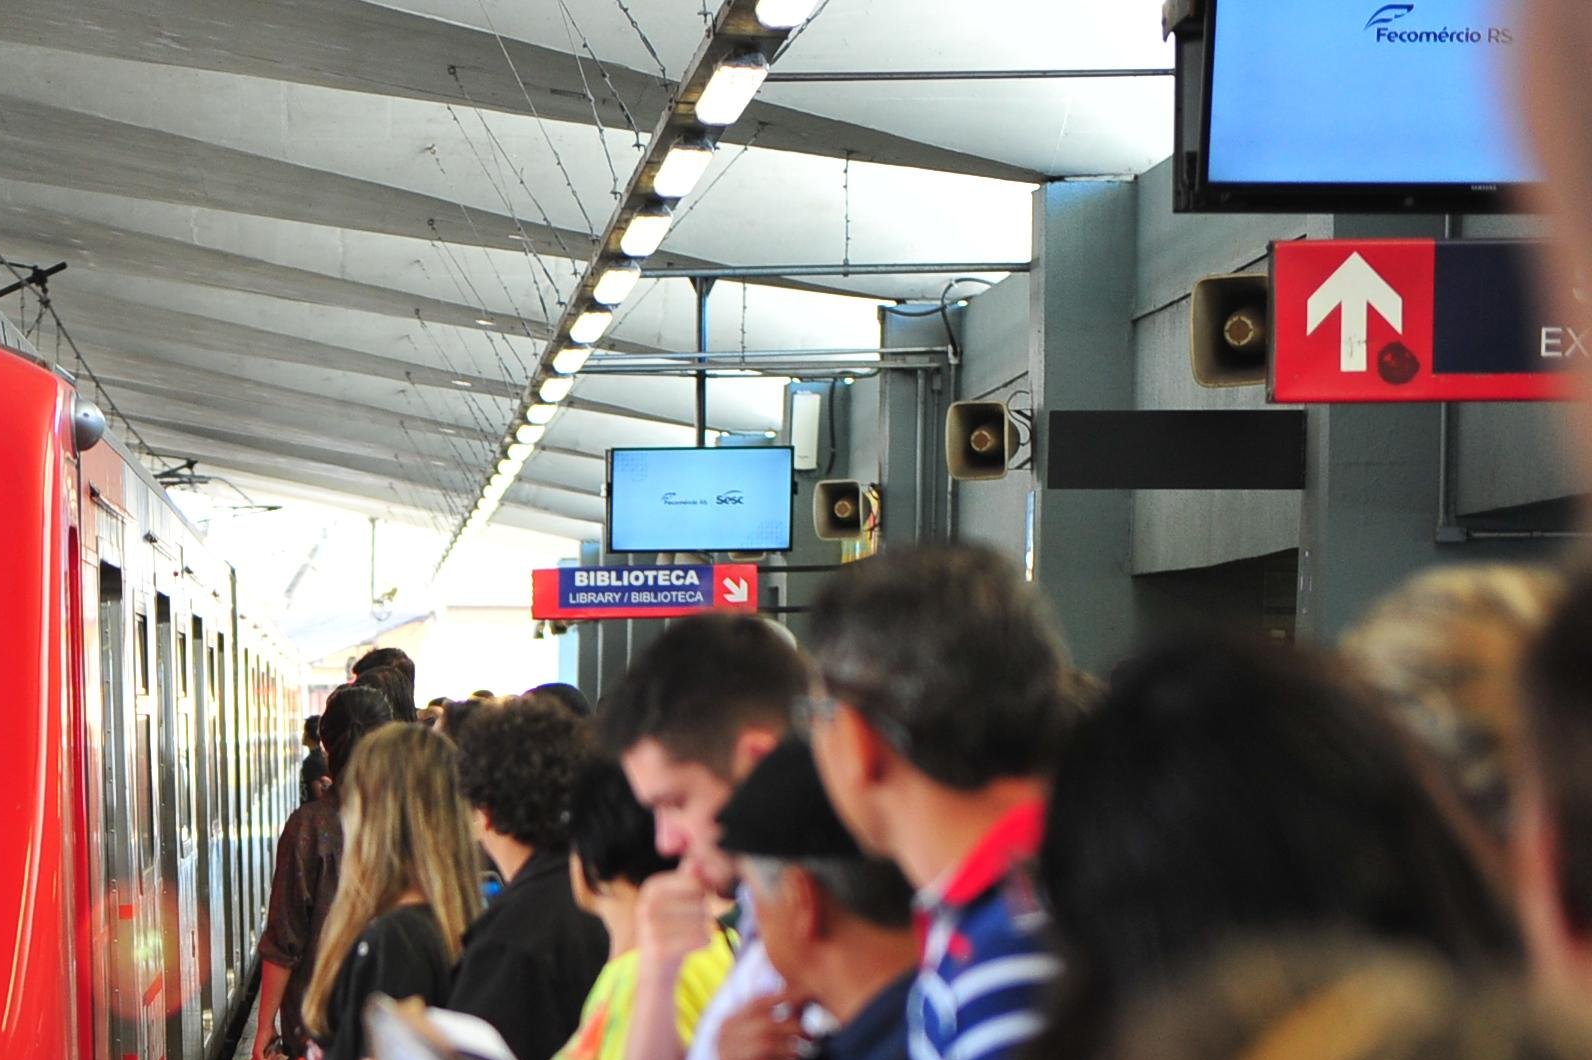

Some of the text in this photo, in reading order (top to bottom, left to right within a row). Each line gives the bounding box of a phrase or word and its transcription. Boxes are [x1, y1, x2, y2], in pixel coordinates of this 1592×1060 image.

[1376, 26, 1513, 43] Fecomércio RS
[574, 569, 700, 587] BIBLIOTECA
[569, 592, 621, 604] LIBRARY
[631, 591, 704, 603] BIBLIOTECA
